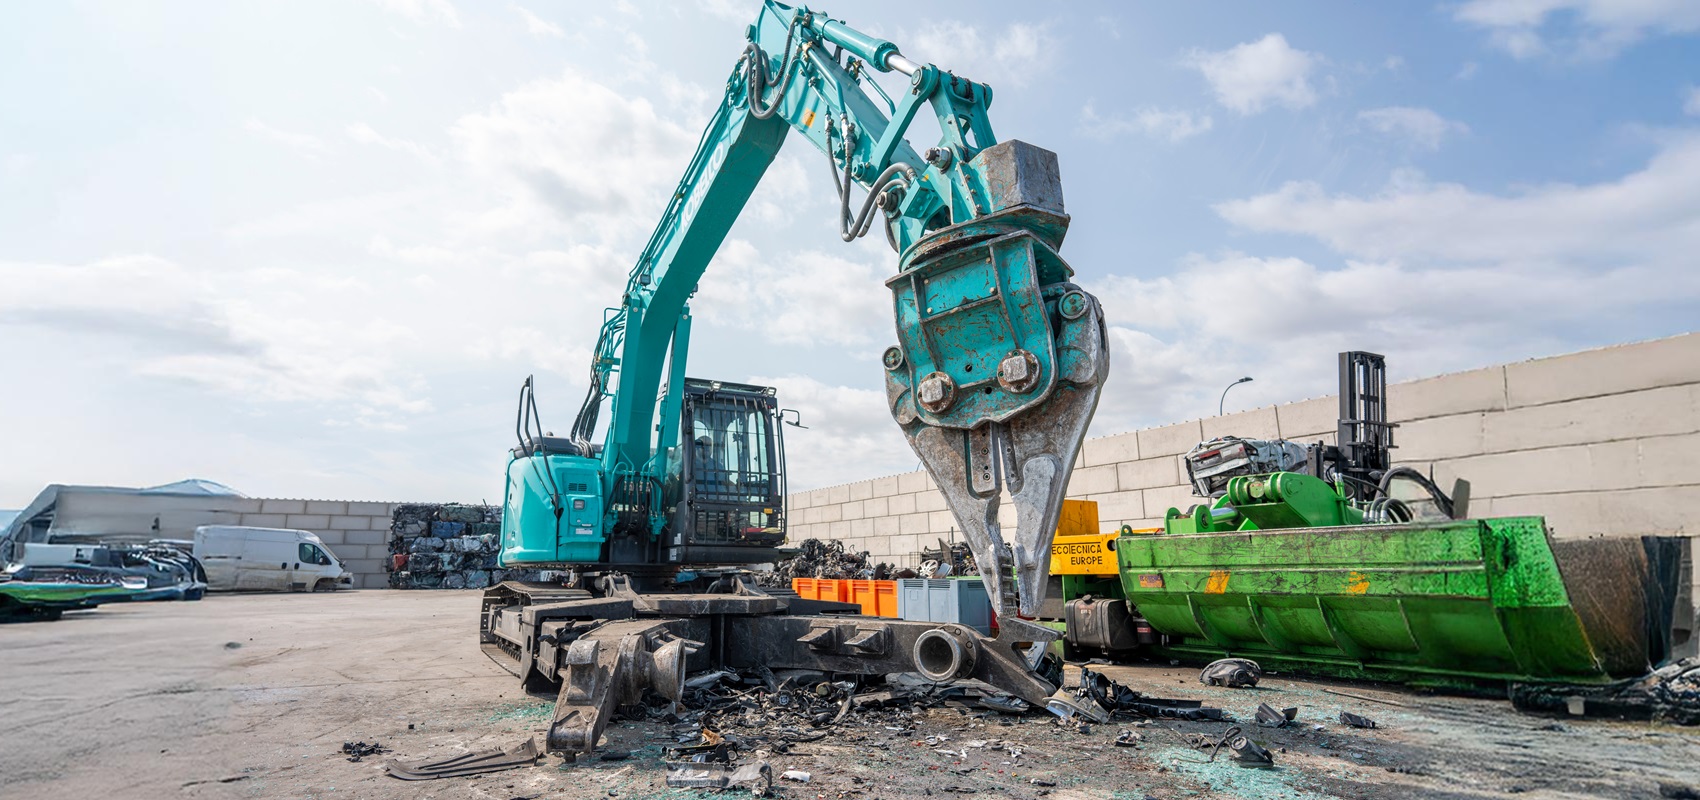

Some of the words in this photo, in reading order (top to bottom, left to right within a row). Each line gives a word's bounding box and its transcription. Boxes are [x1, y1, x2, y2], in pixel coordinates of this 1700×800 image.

[681, 141, 724, 234] KOBELCO
[1051, 542, 1102, 555] ECOTECNICA
[1071, 556, 1103, 565] EUROPE
